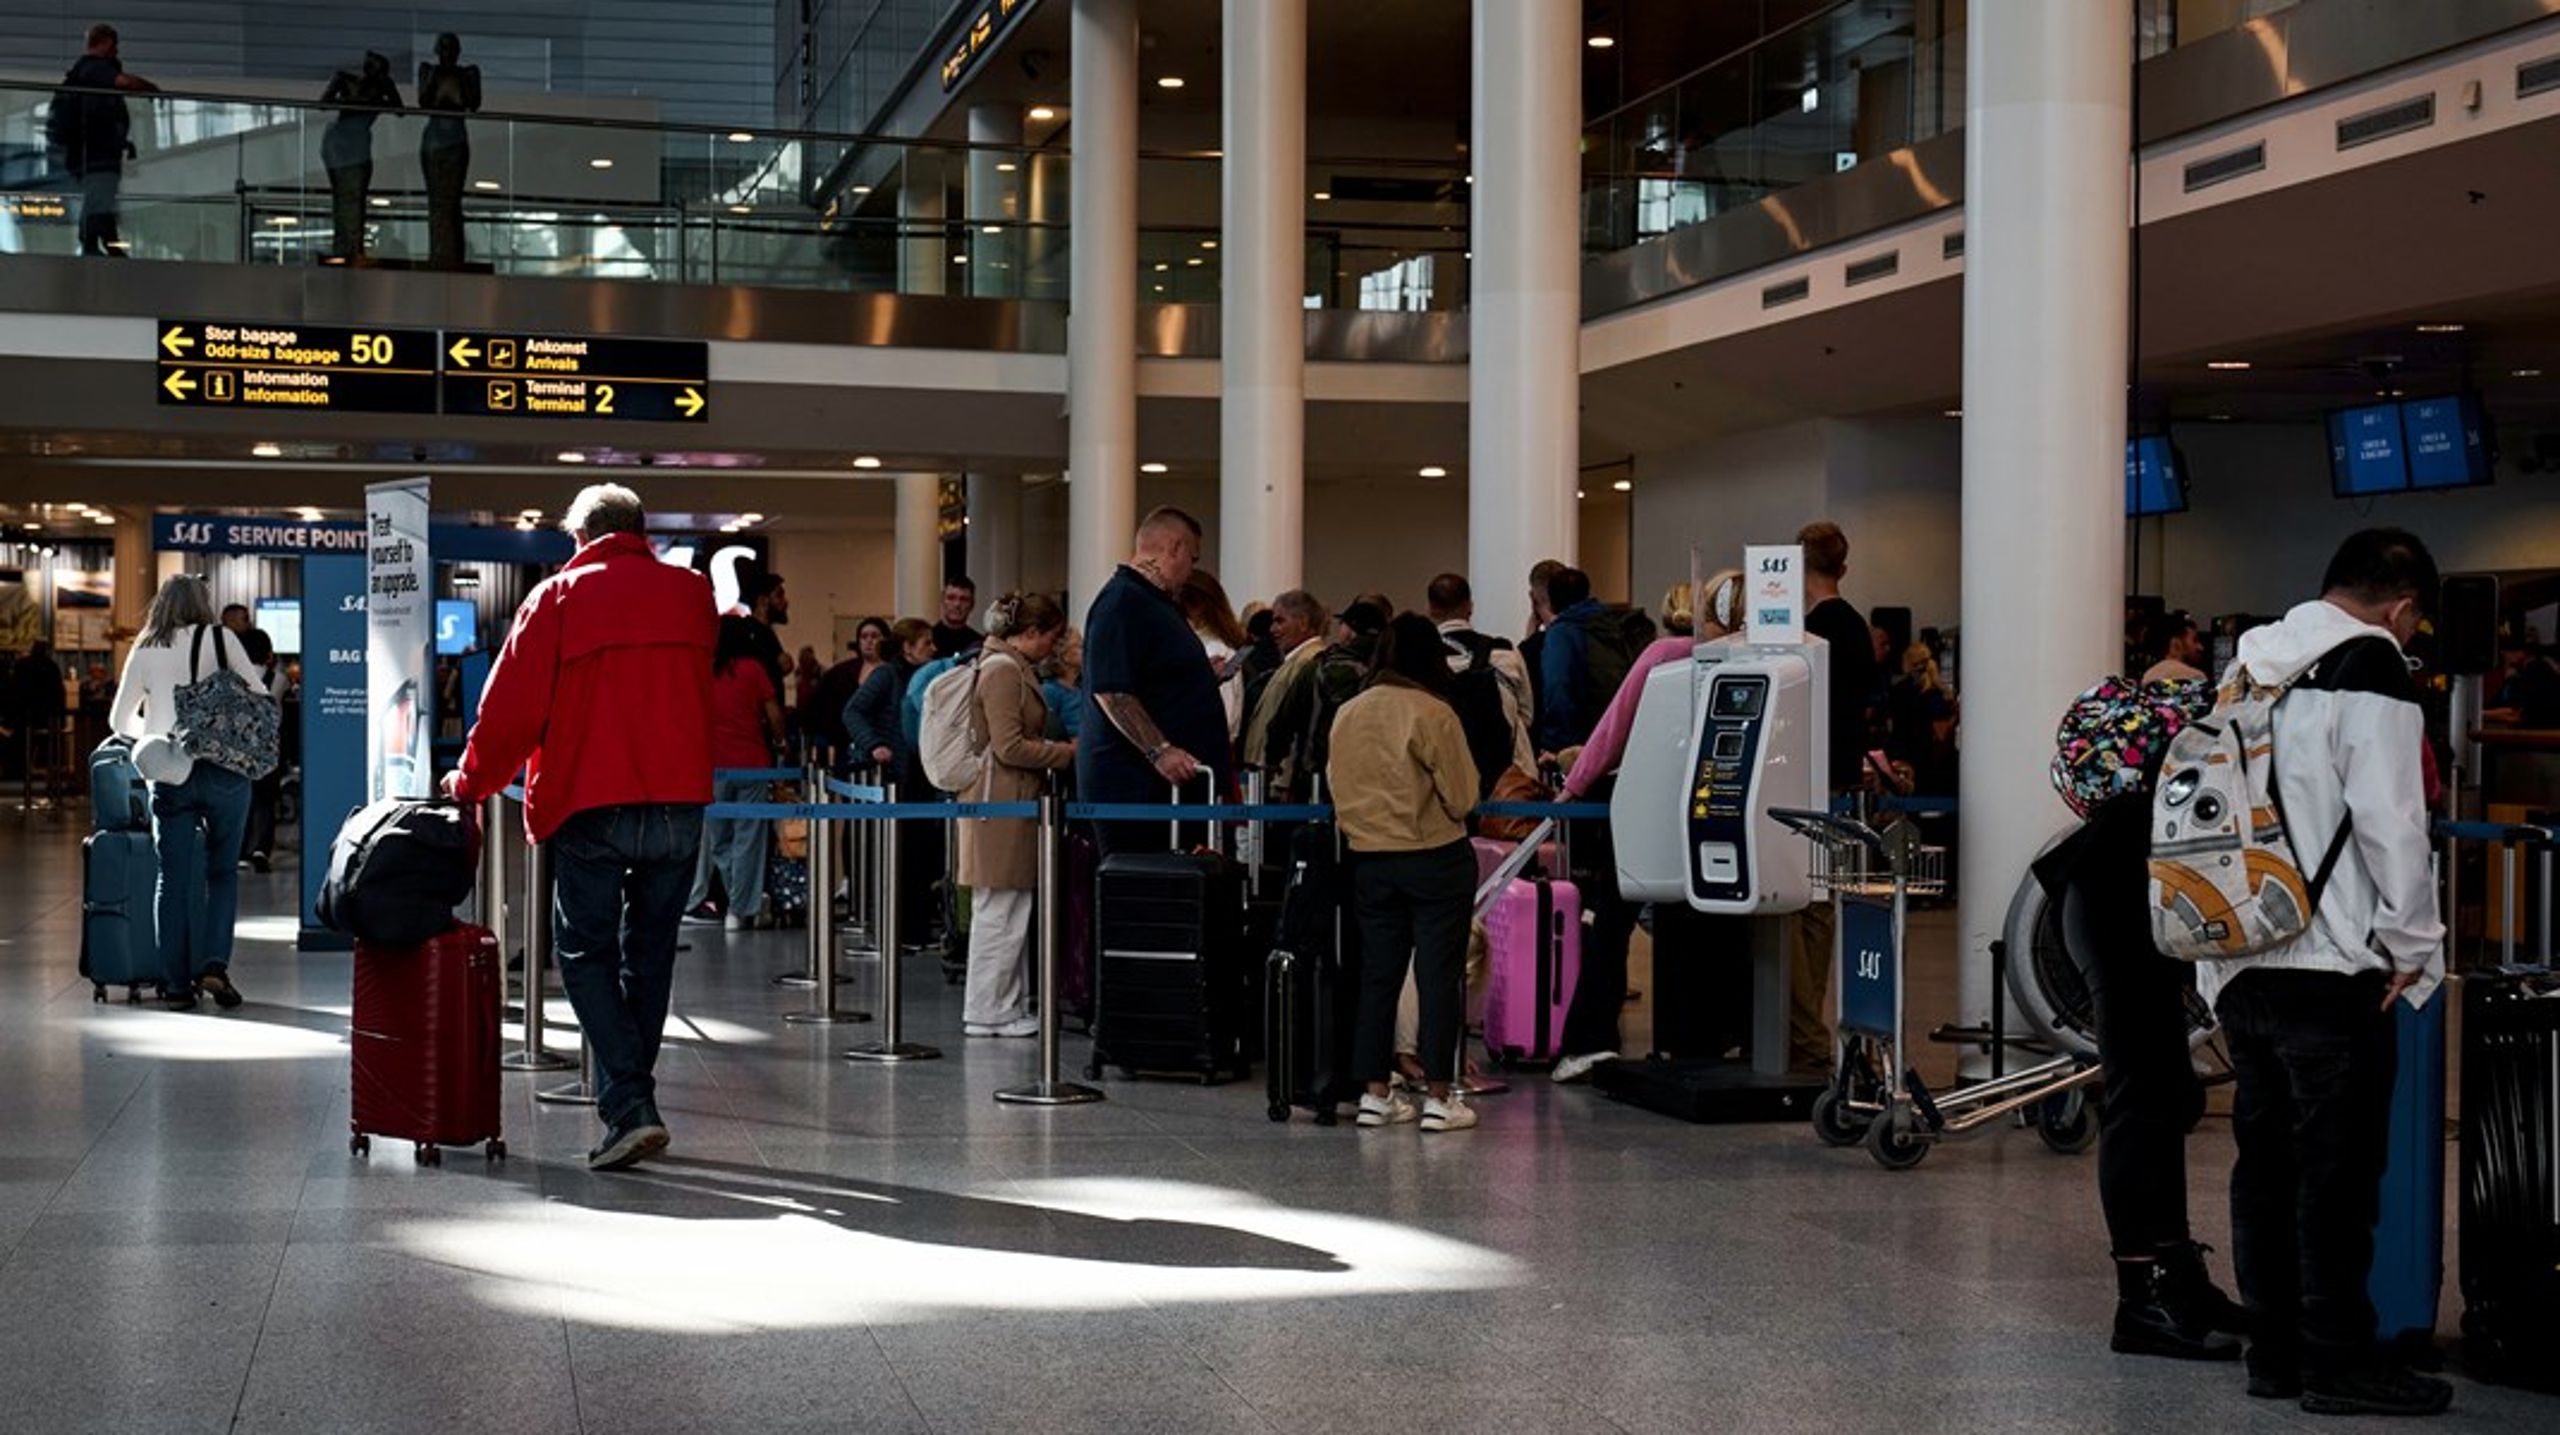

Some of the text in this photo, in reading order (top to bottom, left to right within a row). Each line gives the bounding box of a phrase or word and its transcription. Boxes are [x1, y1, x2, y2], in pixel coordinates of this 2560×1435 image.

[205, 325, 298, 346] Stor bagage
[205, 343, 340, 364] Odd-size baggage
[351, 334, 394, 364] 50
[525, 339, 588, 356] Ankomst
[526, 356, 579, 371] Arrivals
[243, 370, 329, 388] Information
[526, 379, 586, 395] Terminal
[243, 387, 329, 404] Information
[526, 396, 586, 412] Terminal
[594, 385, 615, 414] 2
[371, 512, 392, 537] Treat
[169, 521, 367, 550] SAS SERVICE POINT
[371, 539, 414, 571] yourself to
[1759, 556, 1790, 574] SAS
[371, 568, 419, 599] an upgrade.
[339, 594, 368, 611] SA
[329, 650, 361, 664] BAG
[1856, 949, 1882, 980] SAS
